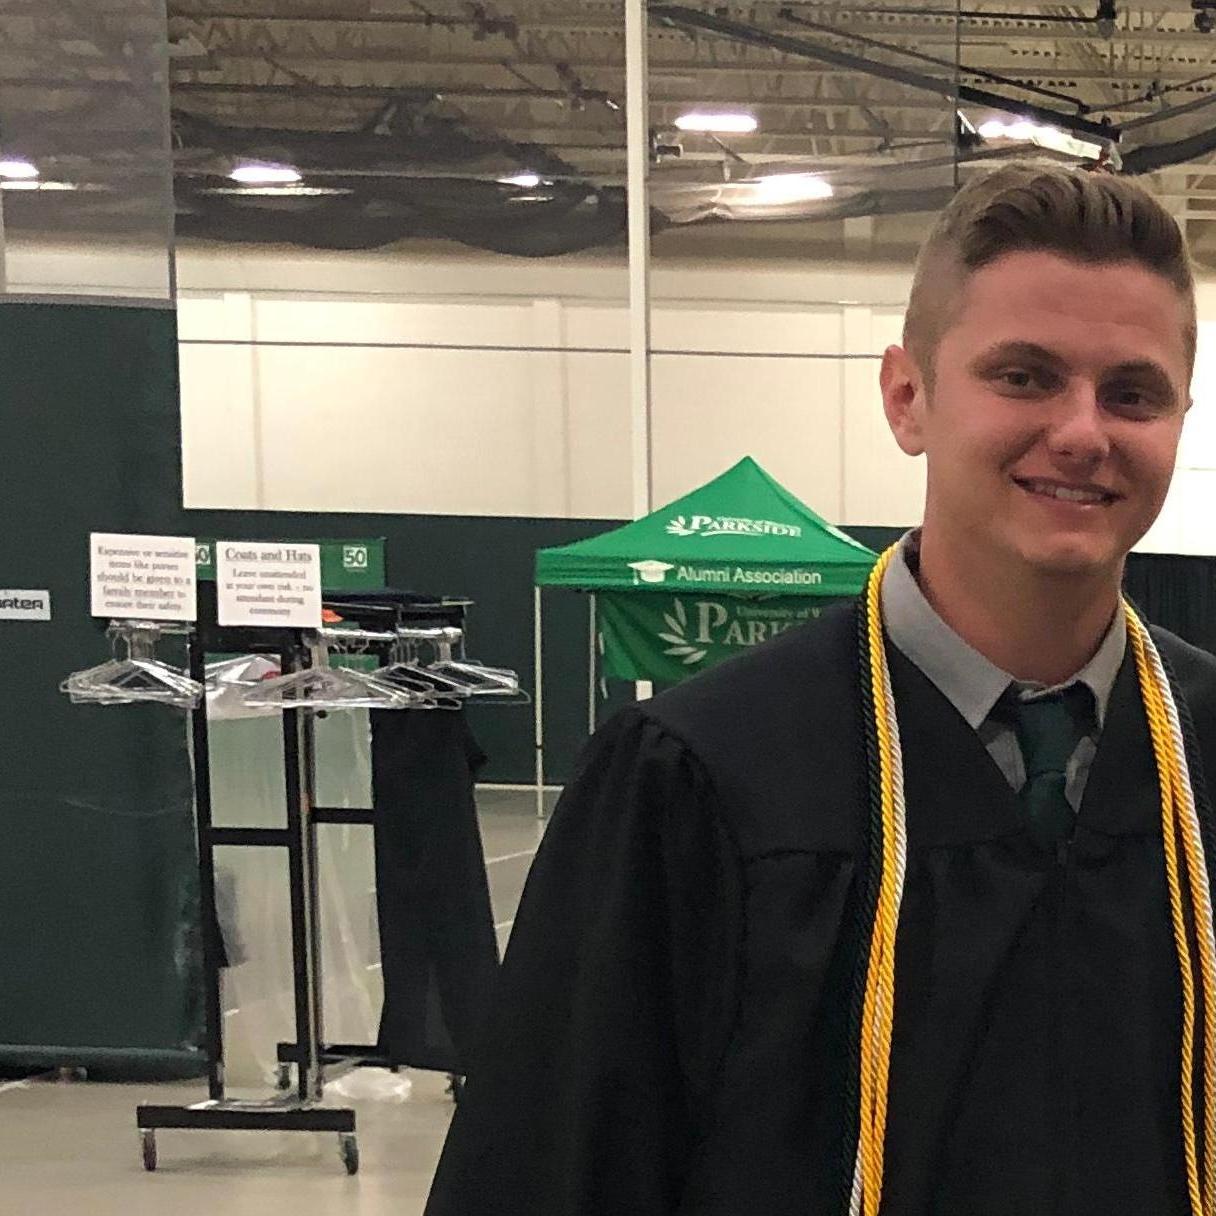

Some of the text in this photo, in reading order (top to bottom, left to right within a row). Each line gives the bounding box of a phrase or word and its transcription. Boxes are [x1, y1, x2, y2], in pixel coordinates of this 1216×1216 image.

[225, 547, 312, 561] Coats and Hats
[345, 550, 365, 565] 50
[677, 565, 822, 585] Alumni Association
